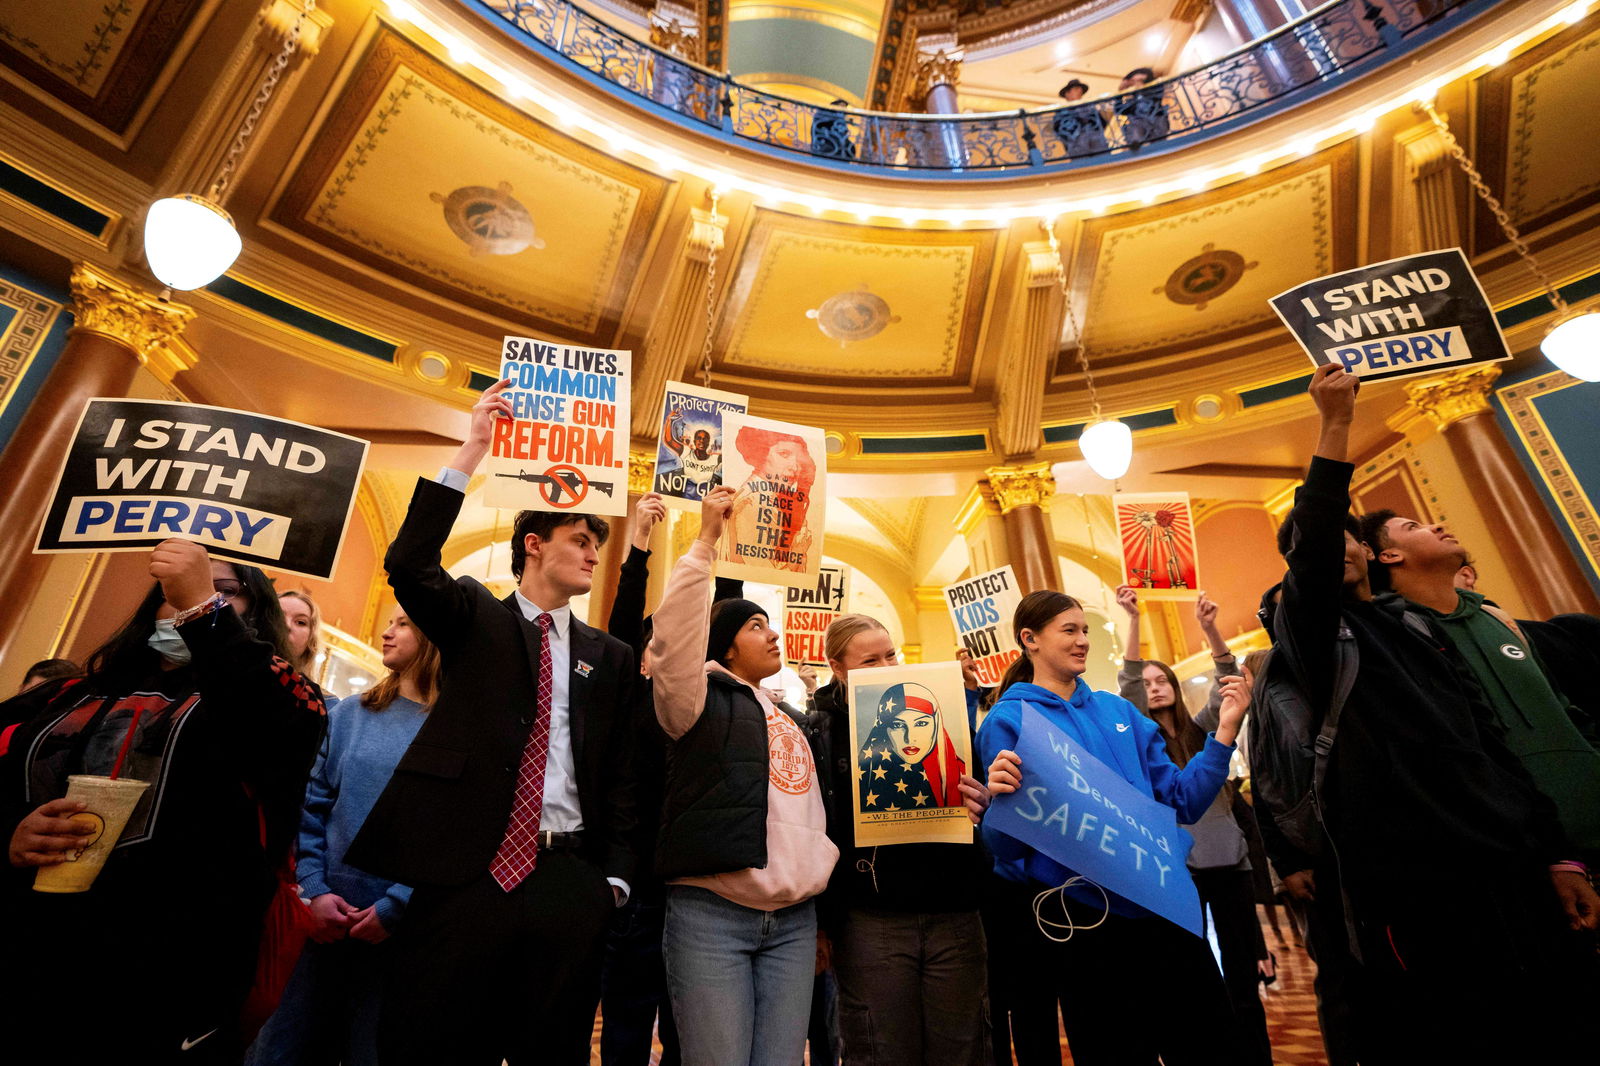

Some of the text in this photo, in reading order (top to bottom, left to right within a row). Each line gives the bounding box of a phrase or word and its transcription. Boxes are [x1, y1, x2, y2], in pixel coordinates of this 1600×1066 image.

[1301, 268, 1451, 318] I STAND
[1316, 303, 1426, 343] WITH
[505, 340, 624, 376] SAVE LIVES.
[1337, 331, 1452, 373] PERRY
[502, 361, 616, 402] COMMON
[572, 400, 616, 429] GUN
[103, 418, 327, 474] I STAND
[491, 417, 624, 469] REFORM.
[96, 458, 250, 499] WITH
[659, 472, 691, 493] NOT
[748, 481, 805, 502] WOMAN'S
[757, 508, 792, 528] IS IN
[759, 494, 793, 511] PLACE
[74, 500, 274, 546] PERRY
[756, 525, 791, 548] THE
[736, 543, 803, 564] RESISTANCE
[948, 571, 1009, 608] PROTECT
[954, 597, 1000, 633] KIDS
[962, 626, 1000, 659] NOT
[770, 750, 807, 765] FLORIDA
[1047, 732, 1081, 770] We
[916, 808, 955, 818] PEOPLE
[1066, 766, 1171, 856] Demand
[1015, 786, 1171, 888] SAFETY
